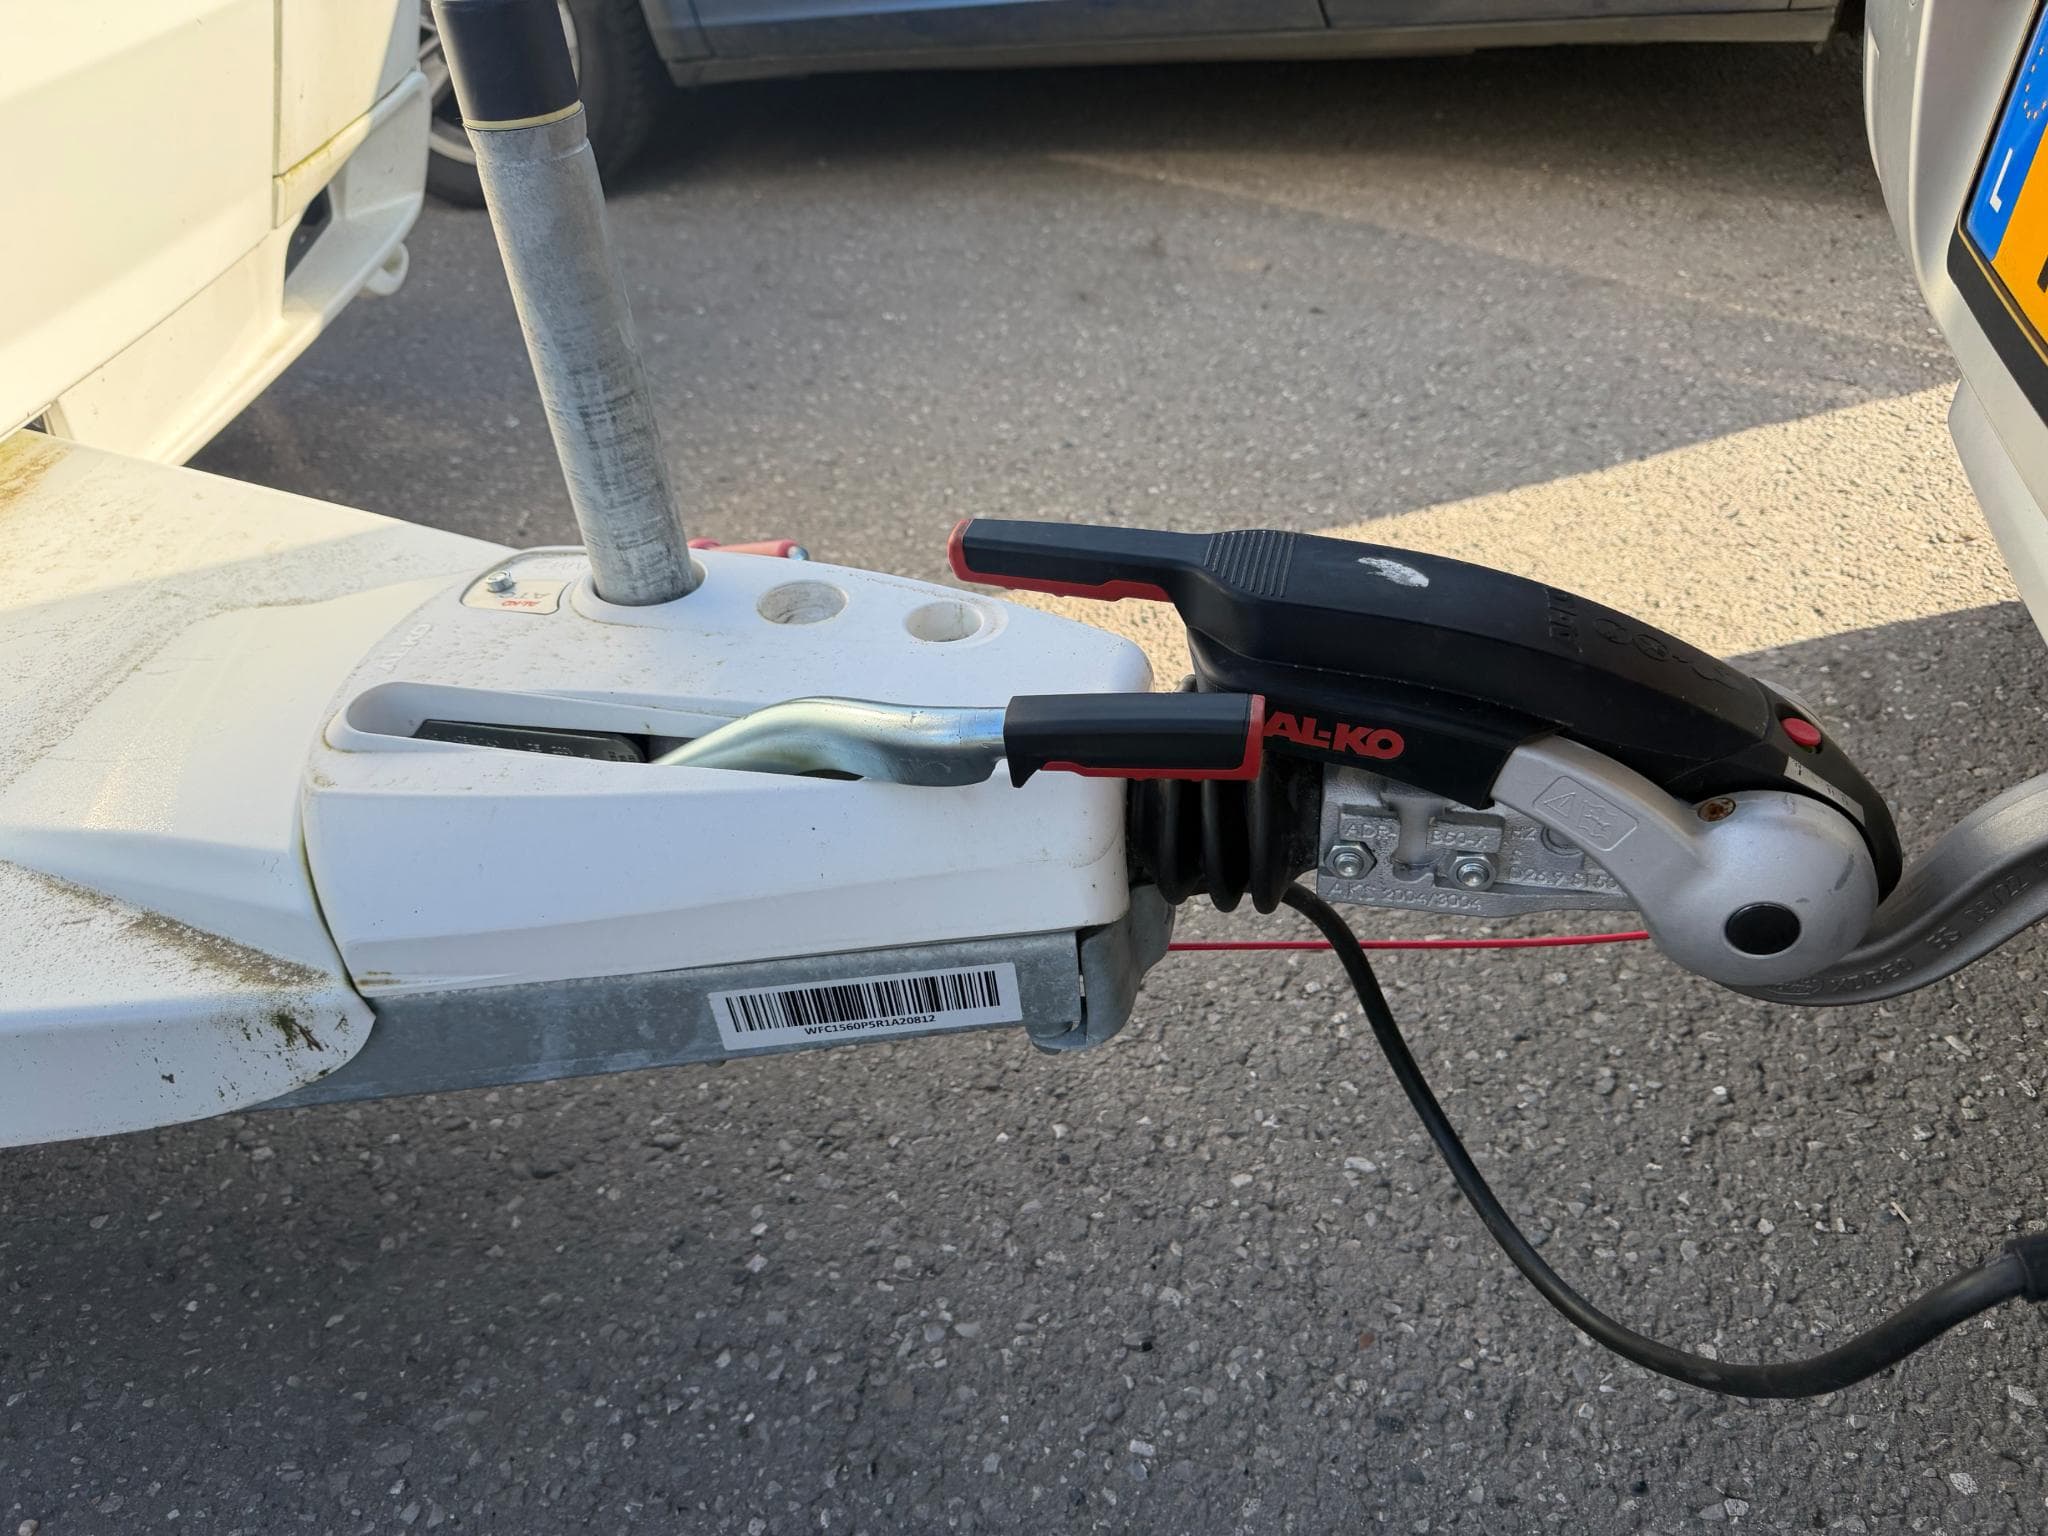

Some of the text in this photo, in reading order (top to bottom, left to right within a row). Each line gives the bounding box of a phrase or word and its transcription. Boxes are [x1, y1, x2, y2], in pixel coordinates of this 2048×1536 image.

[1989, 147, 2014, 213] L
[1263, 711, 1405, 760] AL-KO
[804, 1014, 937, 1035] WFC1560P5R1A20812
